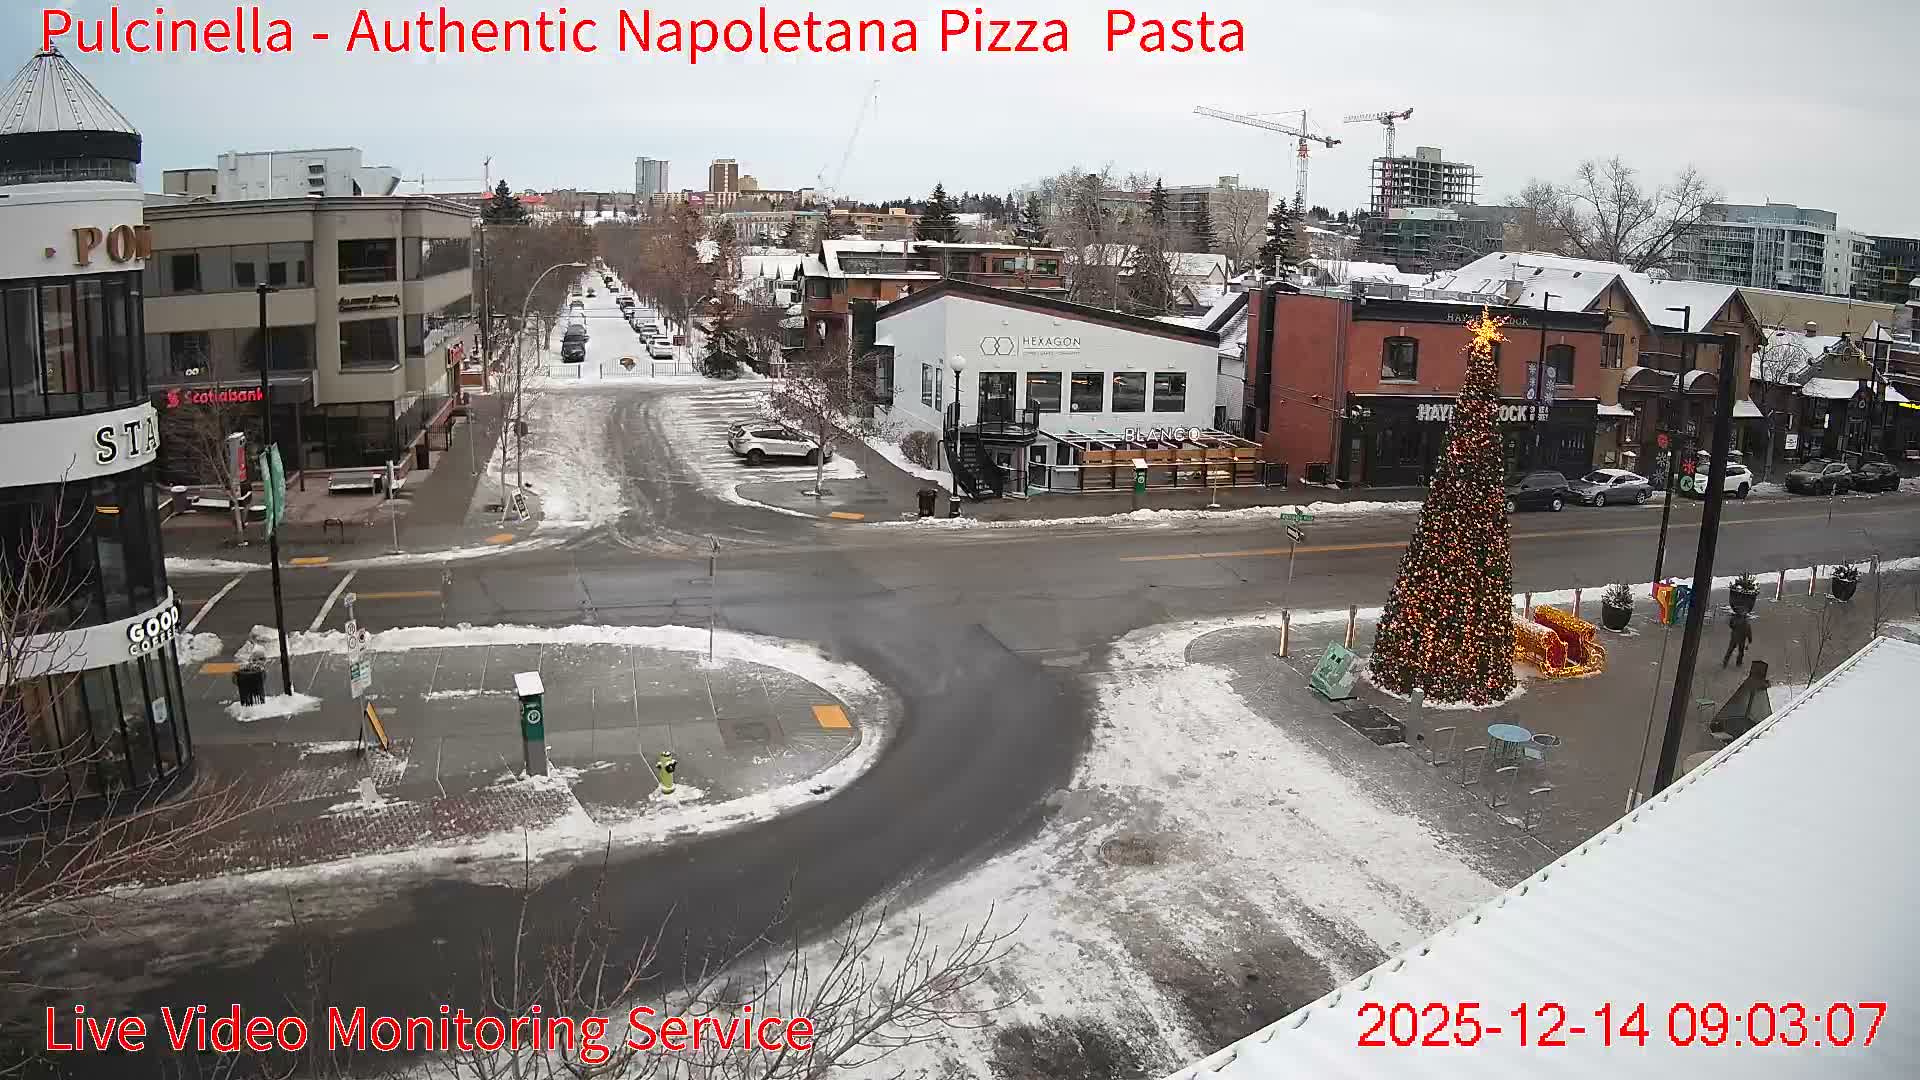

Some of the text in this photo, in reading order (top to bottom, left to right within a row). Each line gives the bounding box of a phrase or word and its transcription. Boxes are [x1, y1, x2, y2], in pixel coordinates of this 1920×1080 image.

[1022, 336, 1081, 347] HEXAGON
[1125, 427, 1201, 442] BLANCO
[128, 605, 179, 643] GOOD
